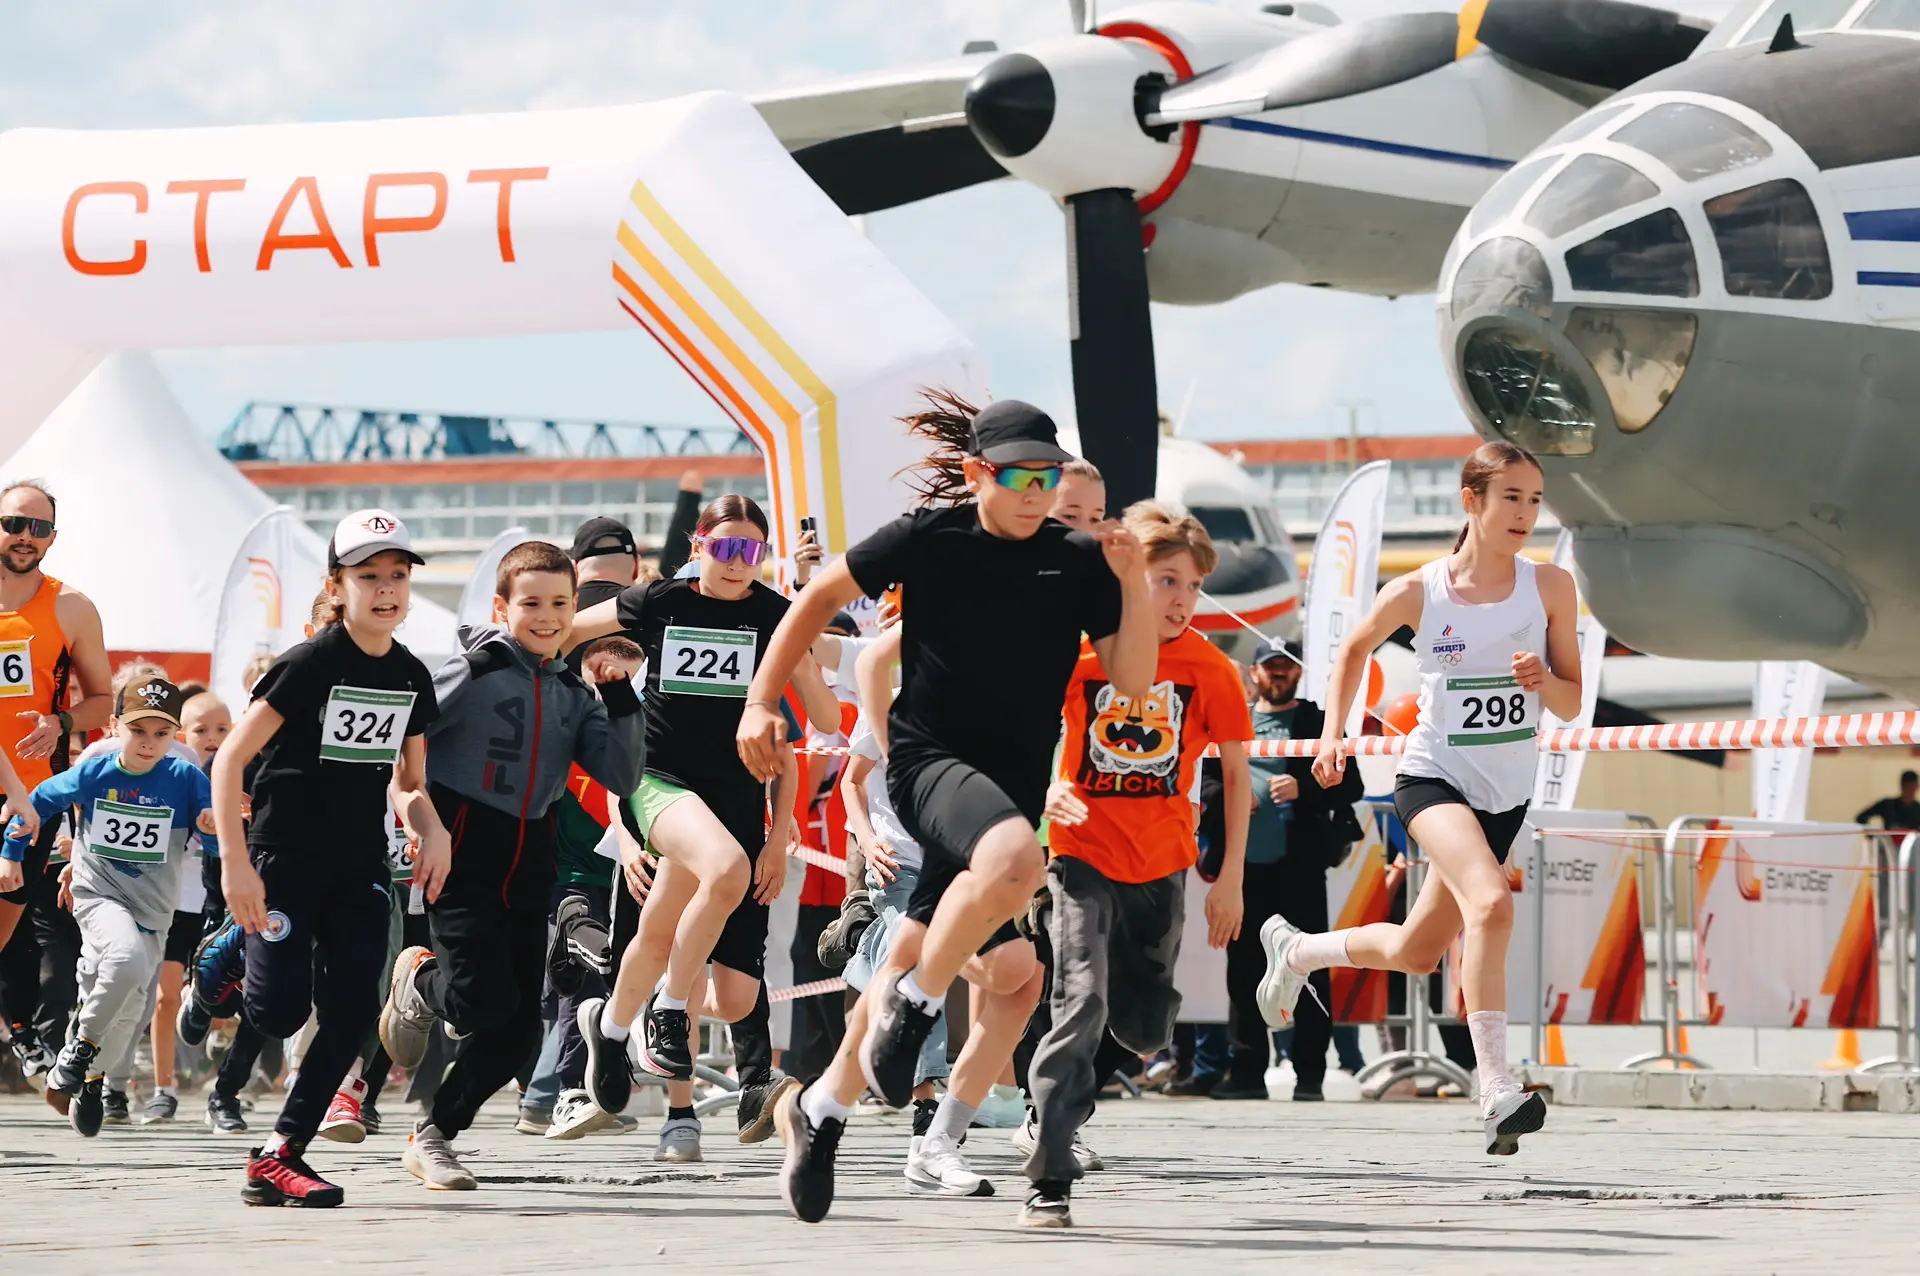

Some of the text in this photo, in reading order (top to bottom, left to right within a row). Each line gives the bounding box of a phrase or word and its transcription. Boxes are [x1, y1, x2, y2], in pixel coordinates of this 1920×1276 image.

[62, 167, 549, 276] СТАРТ
[3, 654, 23, 683] 6
[675, 647, 740, 680] 224
[333, 709, 396, 744] 324
[1462, 693, 1525, 729] 298
[481, 696, 525, 796] FILA
[1080, 769, 1178, 795] TRICKY
[104, 818, 160, 849] 325
